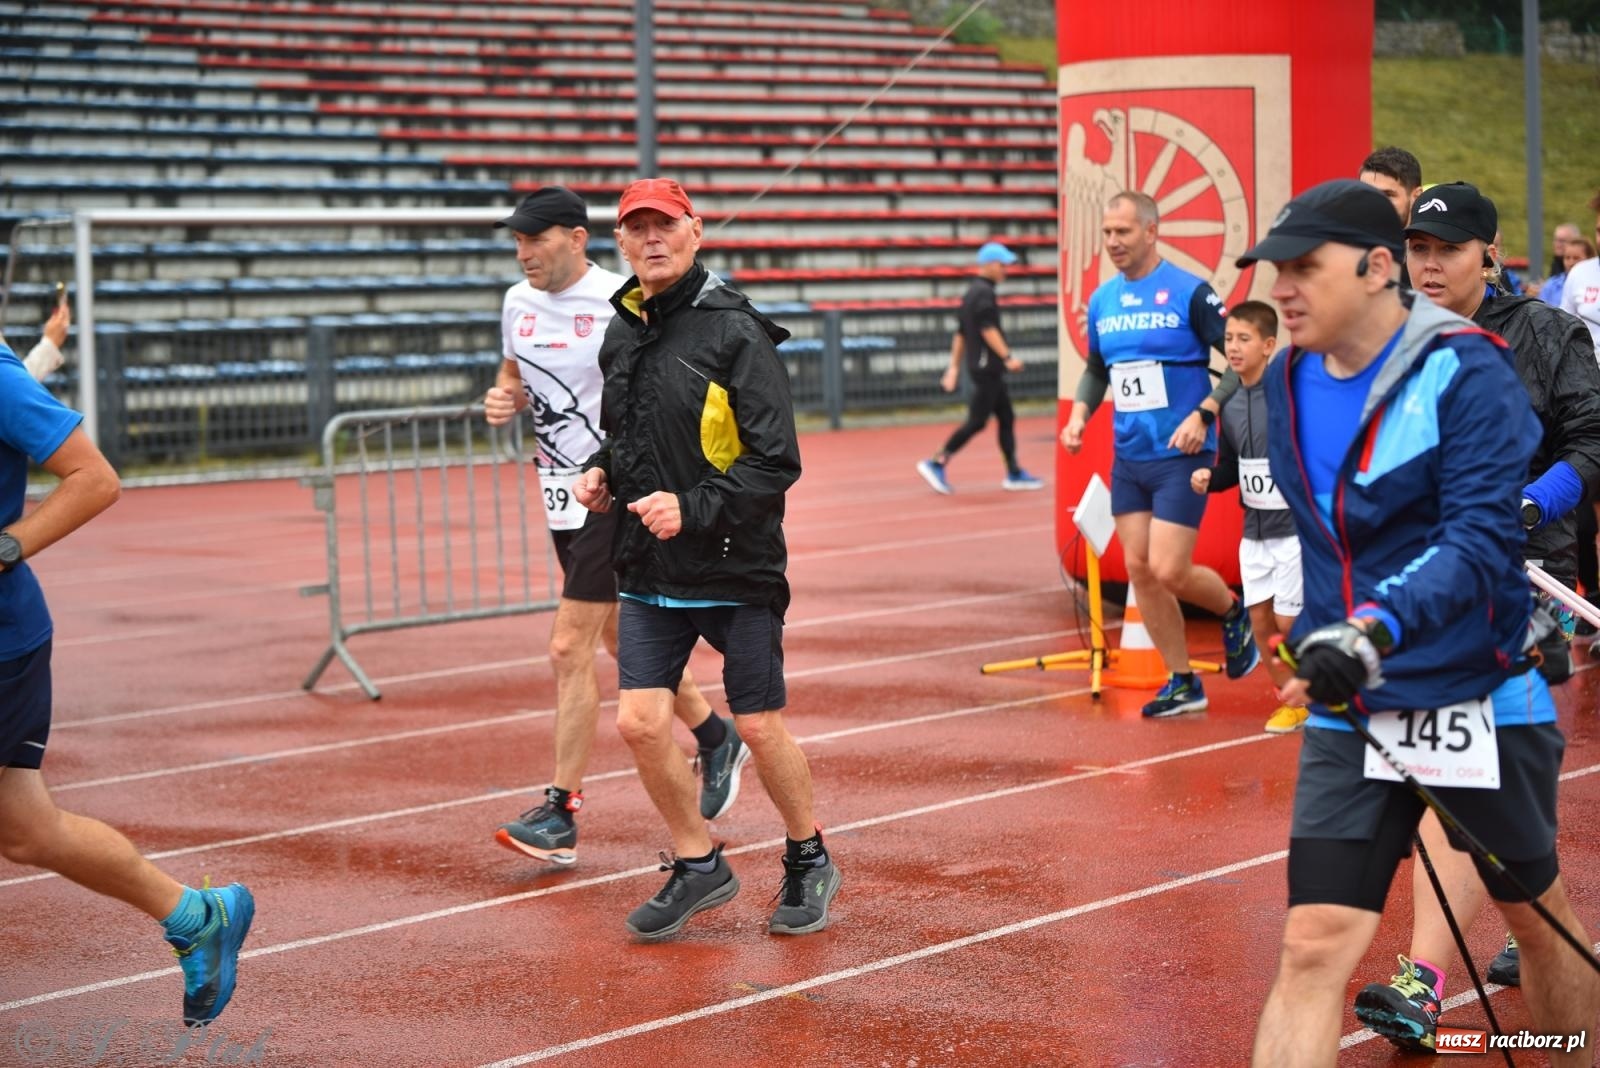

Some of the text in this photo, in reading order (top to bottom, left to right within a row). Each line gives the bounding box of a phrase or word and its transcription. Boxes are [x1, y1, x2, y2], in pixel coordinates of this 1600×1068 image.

[1121, 377, 1146, 397] 61
[1243, 475, 1275, 494] 107
[544, 487, 569, 511] 39
[1397, 708, 1472, 752] 145
